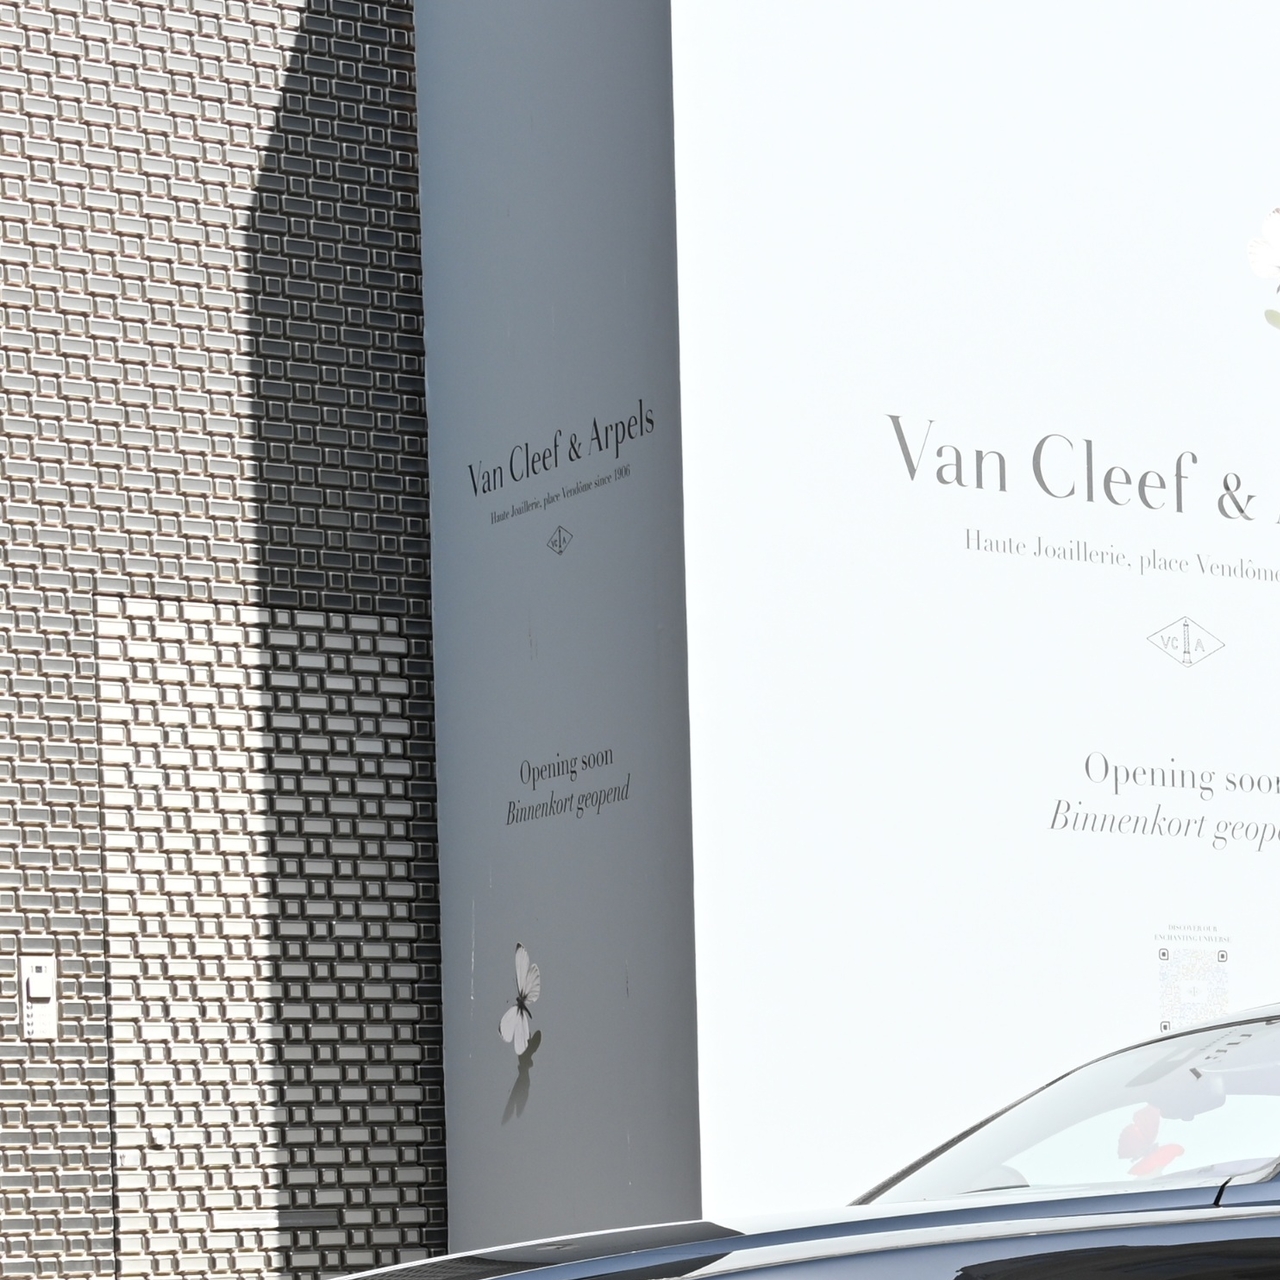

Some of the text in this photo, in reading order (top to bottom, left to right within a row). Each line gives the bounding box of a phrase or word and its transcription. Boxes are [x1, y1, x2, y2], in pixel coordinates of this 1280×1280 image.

[468, 399, 655, 498] Van Cleef & Arpels
[884, 413, 1008, 493] Van
[1031, 433, 1199, 514] Cleef
[1217, 472, 1258, 522] &
[490, 464, 631, 525] Haute Joaillerie, place Vendôme since 1906
[965, 528, 1027, 556] Haute
[1033, 535, 1132, 569] Joaillerie,
[1139, 549, 1189, 576] place
[519, 747, 614, 791] Opening soon
[1084, 751, 1216, 801] Opening
[505, 773, 631, 827] Binnenkort geopend
[1047, 798, 1206, 839] Binnenkort
